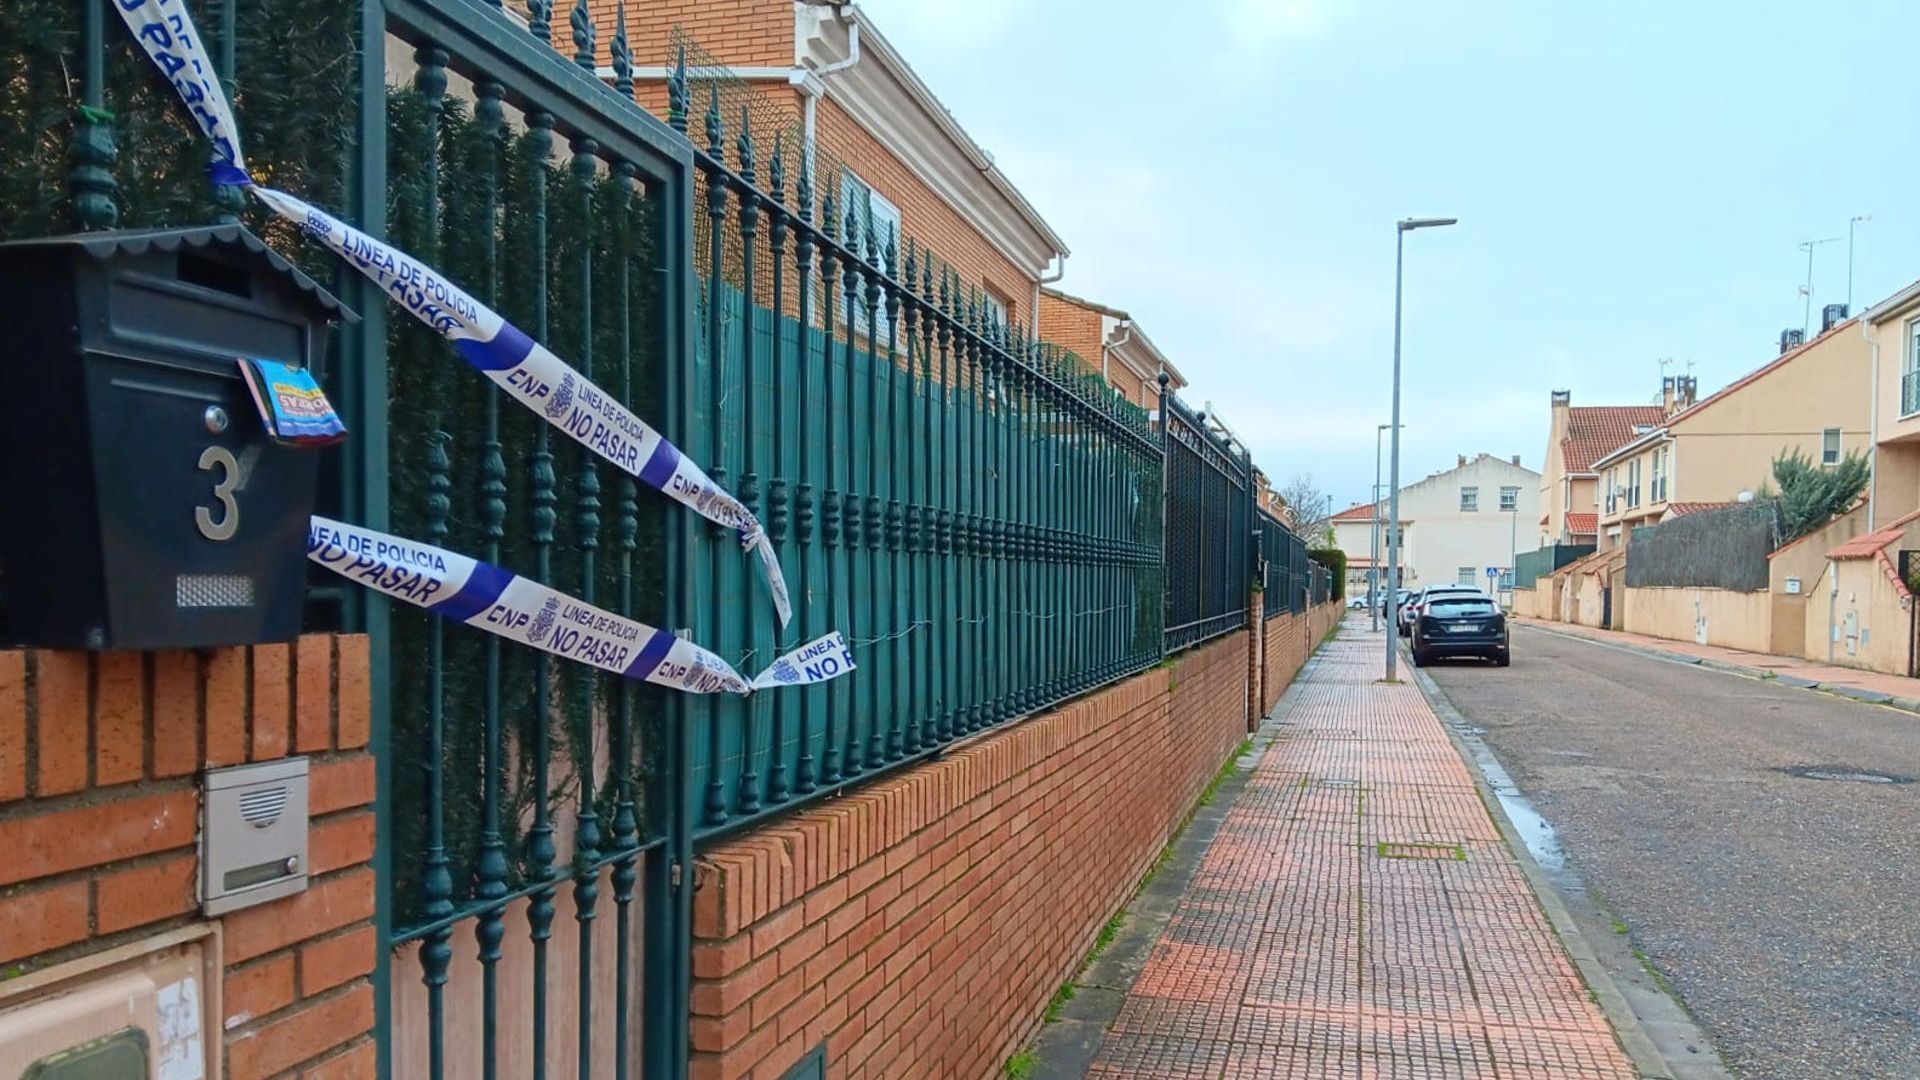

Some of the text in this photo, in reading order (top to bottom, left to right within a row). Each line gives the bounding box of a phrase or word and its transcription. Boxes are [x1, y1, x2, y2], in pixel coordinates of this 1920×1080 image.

[342, 229, 396, 274] LINEA
[400, 260, 422, 289] DE
[425, 275, 479, 325] POLICIA
[506, 368, 550, 399] CNP
[578, 383, 644, 443] LINEA DE POLICIA
[563, 406, 638, 471] NO PASAR
[195, 445, 239, 541] 3
[673, 474, 700, 496] CNP
[347, 534, 372, 556] DE
[377, 541, 447, 573] POLICIA
[344, 554, 442, 603] PASAR
[486, 604, 530, 629] CNP
[562, 604, 639, 642] LINEA DE POLICIA
[547, 625, 629, 669] NO PASAR
[796, 638, 837, 663] LINEA
[658, 661, 687, 680] CNP
[804, 656, 840, 682] NO
